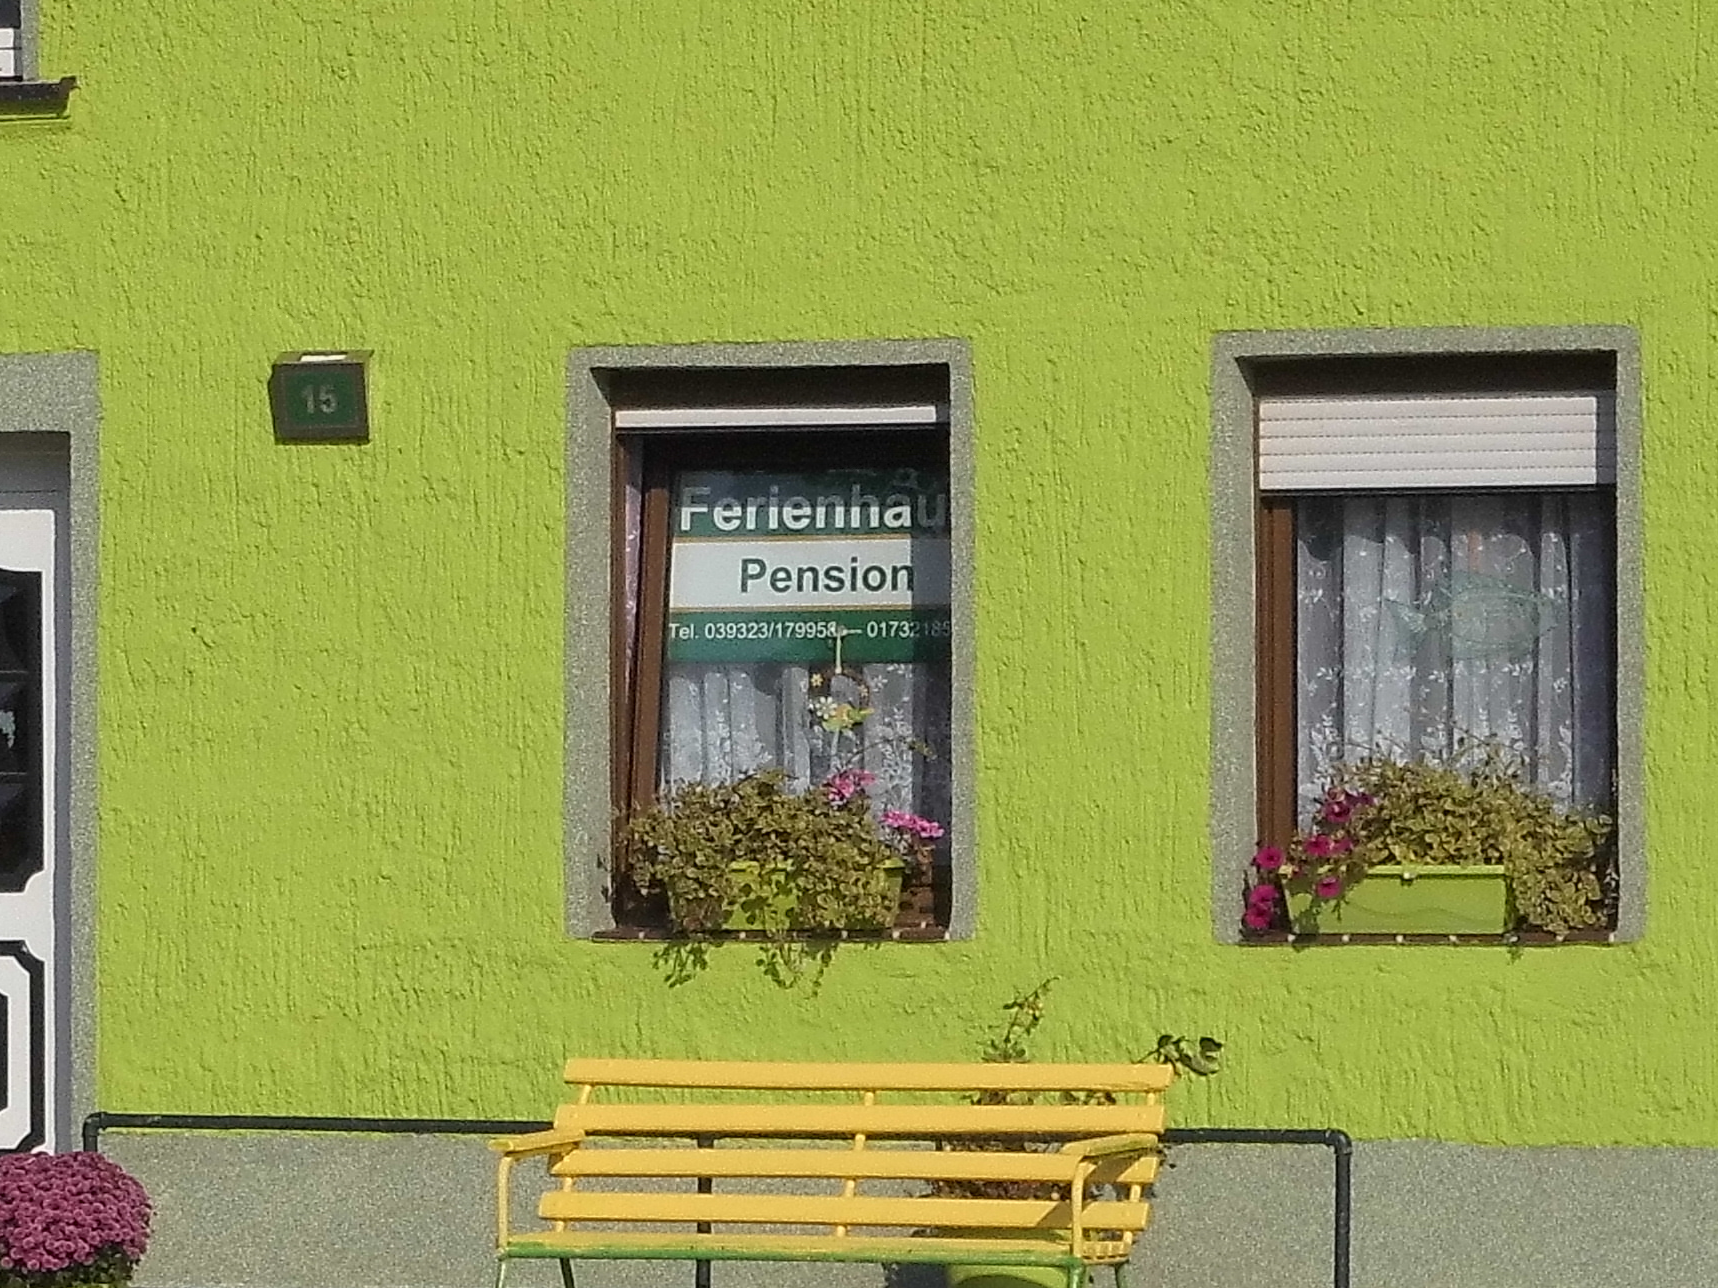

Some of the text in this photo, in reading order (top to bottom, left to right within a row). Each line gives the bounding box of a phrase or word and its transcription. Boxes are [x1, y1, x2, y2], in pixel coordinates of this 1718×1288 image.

[303, 384, 336, 414] 15
[740, 556, 914, 593] Pension
[669, 623, 699, 640] Tel.
[704, 621, 837, 640] 039323/179958
